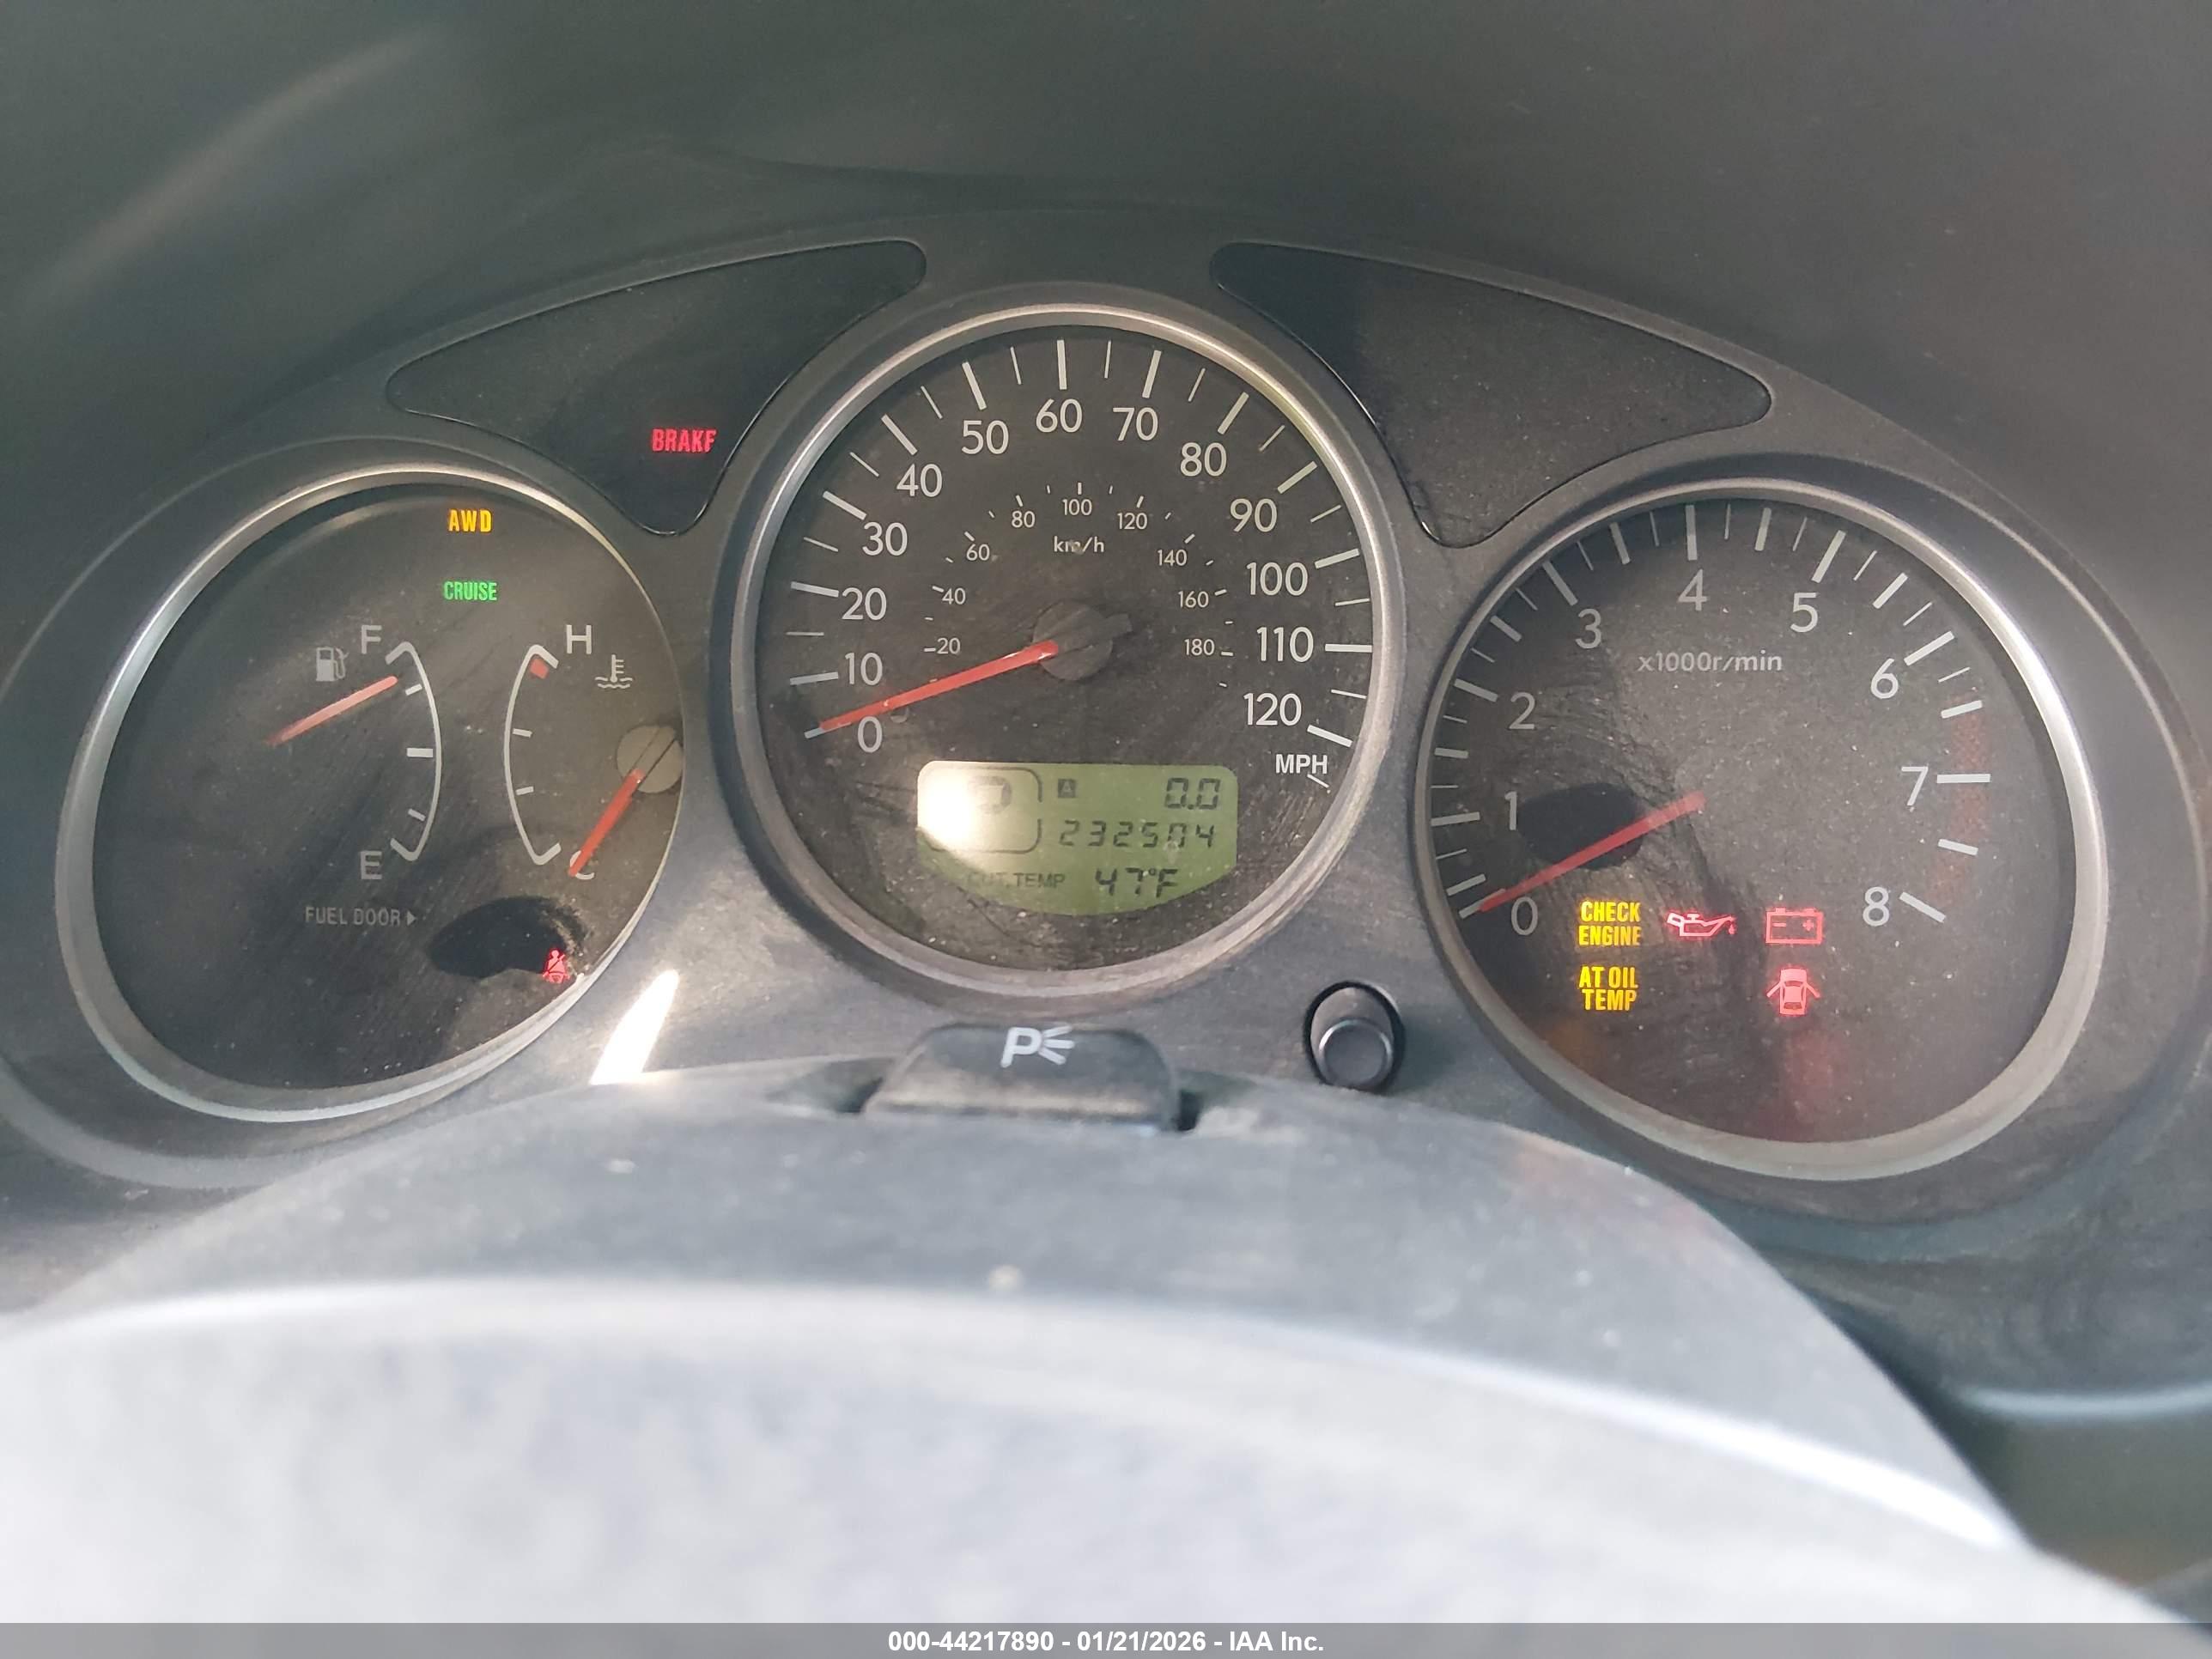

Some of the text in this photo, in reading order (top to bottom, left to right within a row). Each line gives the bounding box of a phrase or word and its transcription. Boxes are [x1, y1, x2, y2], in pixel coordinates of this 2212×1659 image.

[1036, 399, 1082, 432] 60
[1113, 408, 1158, 441] 70
[962, 421, 1008, 453] 50
[1181, 442, 1226, 476] 80
[896, 464, 942, 496] 40
[449, 510, 491, 532] AWD
[1012, 511, 1035, 527] 80
[1063, 499, 1091, 515] 100
[1118, 513, 1147, 529] 120
[1231, 499, 1277, 532] 90
[863, 522, 907, 556] 30
[967, 544, 989, 560] 60
[1158, 550, 1187, 566] 140
[445, 581, 496, 600] CRUISE
[1247, 562, 1308, 595] 100
[1678, 569, 1707, 611] 4
[842, 587, 886, 620] 20
[942, 588, 965, 605] 40
[1179, 591, 1208, 607] 160
[1790, 592, 1818, 632] 5
[361, 625, 381, 654] F
[566, 625, 592, 653] H
[1257, 627, 1313, 662] 110
[1576, 609, 1602, 648] 3
[938, 638, 960, 653] 20
[1185, 639, 1214, 655] 180
[1638, 650, 1782, 671] x1000r/min
[845, 653, 882, 685] 10
[1871, 659, 1899, 699] 6
[1244, 693, 1301, 726] 120
[1510, 692, 1534, 729] 2
[857, 718, 882, 752] 0
[1276, 754, 1327, 775] MPH
[1164, 777, 1220, 810] 0.0
[1901, 766, 1928, 805] 7
[1504, 791, 1517, 830] 1
[1059, 820, 1215, 848] 232504
[361, 851, 382, 879] E
[306, 906, 400, 926] FUEL DOOR
[1510, 895, 1538, 935] 0
[1582, 902, 1640, 922] CHECK
[1863, 887, 1890, 927] 8
[1579, 926, 1640, 945] ENGINE
[1579, 966, 1638, 988] AT OIL
[1582, 989, 1637, 1010] TEMP
